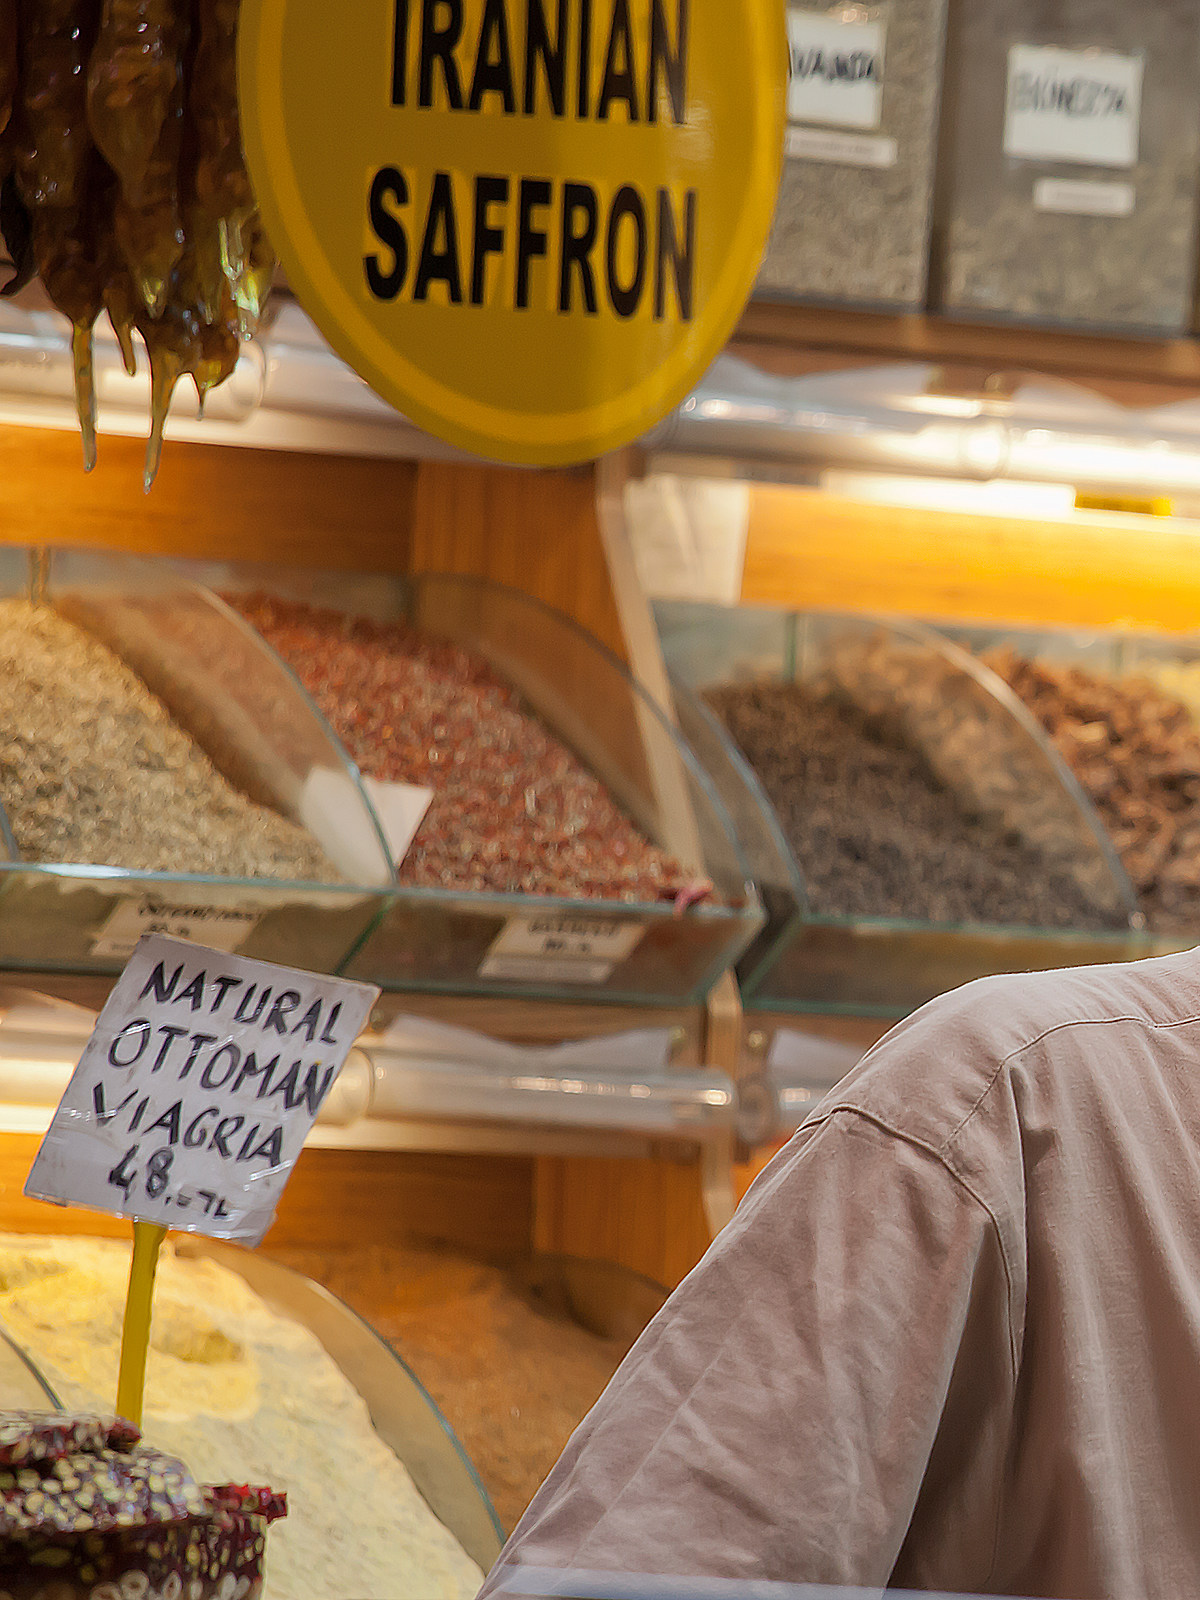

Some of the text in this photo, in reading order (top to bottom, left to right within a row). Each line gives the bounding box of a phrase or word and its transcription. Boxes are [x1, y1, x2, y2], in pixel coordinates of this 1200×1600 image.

[391, 0, 689, 125] IRANIAN
[363, 166, 696, 321] SAFFRON
[139, 960, 344, 1044] NATURAL
[108, 1019, 334, 1116] OTTOMAN
[93, 1081, 283, 1167] VIAGRIA
